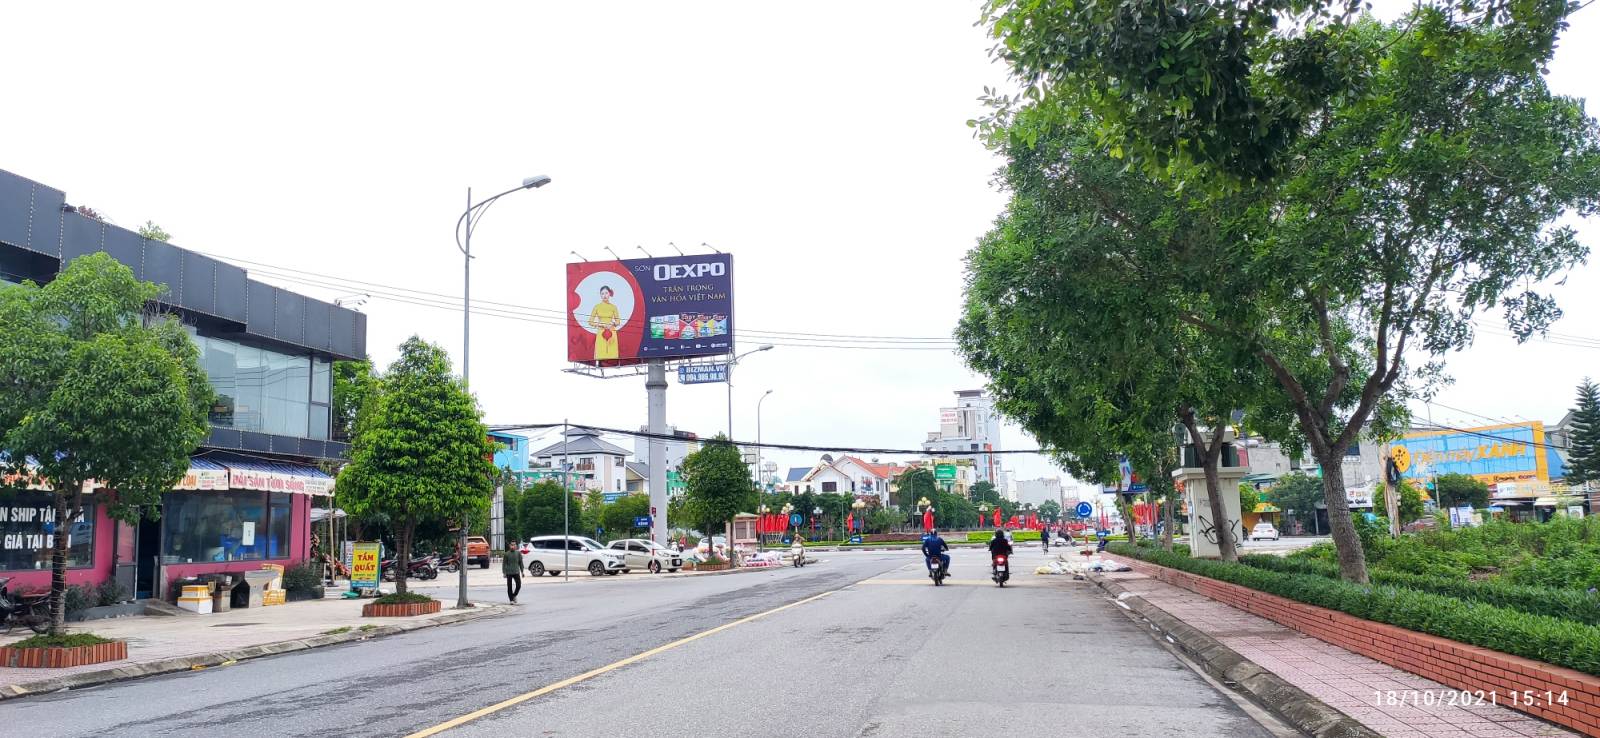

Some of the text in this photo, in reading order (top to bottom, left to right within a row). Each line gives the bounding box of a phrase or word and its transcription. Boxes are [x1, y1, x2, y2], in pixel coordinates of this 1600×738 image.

[653, 262, 725, 281] OEXPO
[707, 292, 726, 301] NAM
[1475, 441, 1527, 462] XANH
[11, 507, 37, 522] SHIP
[26, 534, 43, 552] TẠI
